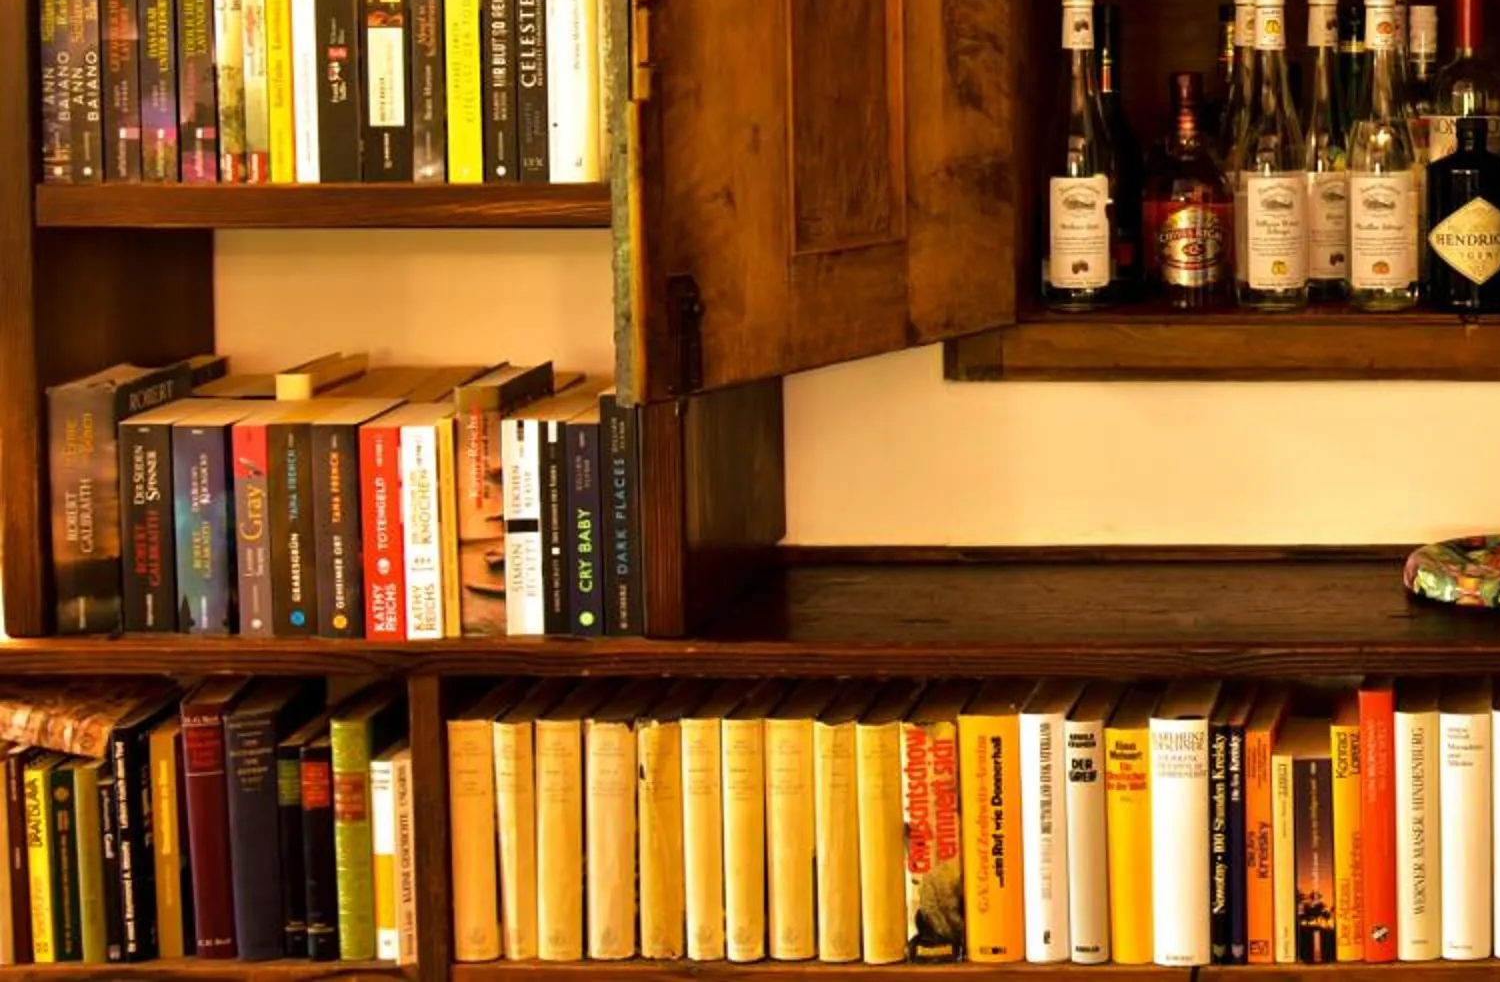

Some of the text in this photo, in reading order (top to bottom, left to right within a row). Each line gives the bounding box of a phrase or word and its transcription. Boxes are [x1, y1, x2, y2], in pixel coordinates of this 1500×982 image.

[490, 38, 507, 66] BLUT
[42, 66, 55, 105] ANN
[57, 50, 71, 122] BAIANO
[72, 65, 85, 105] ANN
[85, 50, 99, 122] BAIANO
[287, 448, 298, 520] TANA FRENCH
[329, 451, 342, 523] TANA FRENCH
[419, 469, 433, 545] KNOCHEN
[613, 458, 627, 520] PLACES
[65, 490, 78, 542] ROBERT
[79, 477, 94, 554] GALBRAITH
[239, 483, 266, 541] Gray
[374, 476, 389, 552] TOTENGELD
[134, 522, 146, 574] ROBERT
[146, 510, 161, 587] GALBRAITH
[289, 532, 302, 602] GRABESGRÜN
[333, 534, 345, 609] GEHEIMER ORT
[510, 542, 523, 594] SIMON
[577, 507, 593, 593] CRY BABY
[615, 527, 629, 576] DARK
[372, 582, 385, 632] KATHY
[384, 582, 398, 632] REICHS
[411, 585, 423, 633] KATHY
[423, 583, 437, 632] REICHS
[928, 738, 954, 777] sich
[1071, 758, 1094, 770] DER
[1228, 734, 1241, 772] Kreisky
[1338, 731, 1350, 779] Konrad
[1350, 730, 1361, 776] Lorenz
[1211, 733, 1227, 853] 100 Stunden Kreisky
[990, 809, 1004, 858] Ruf wie
[1411, 728, 1426, 916] WERNER MASER HINDENBURG
[1257, 821, 1271, 879] Kreisky
